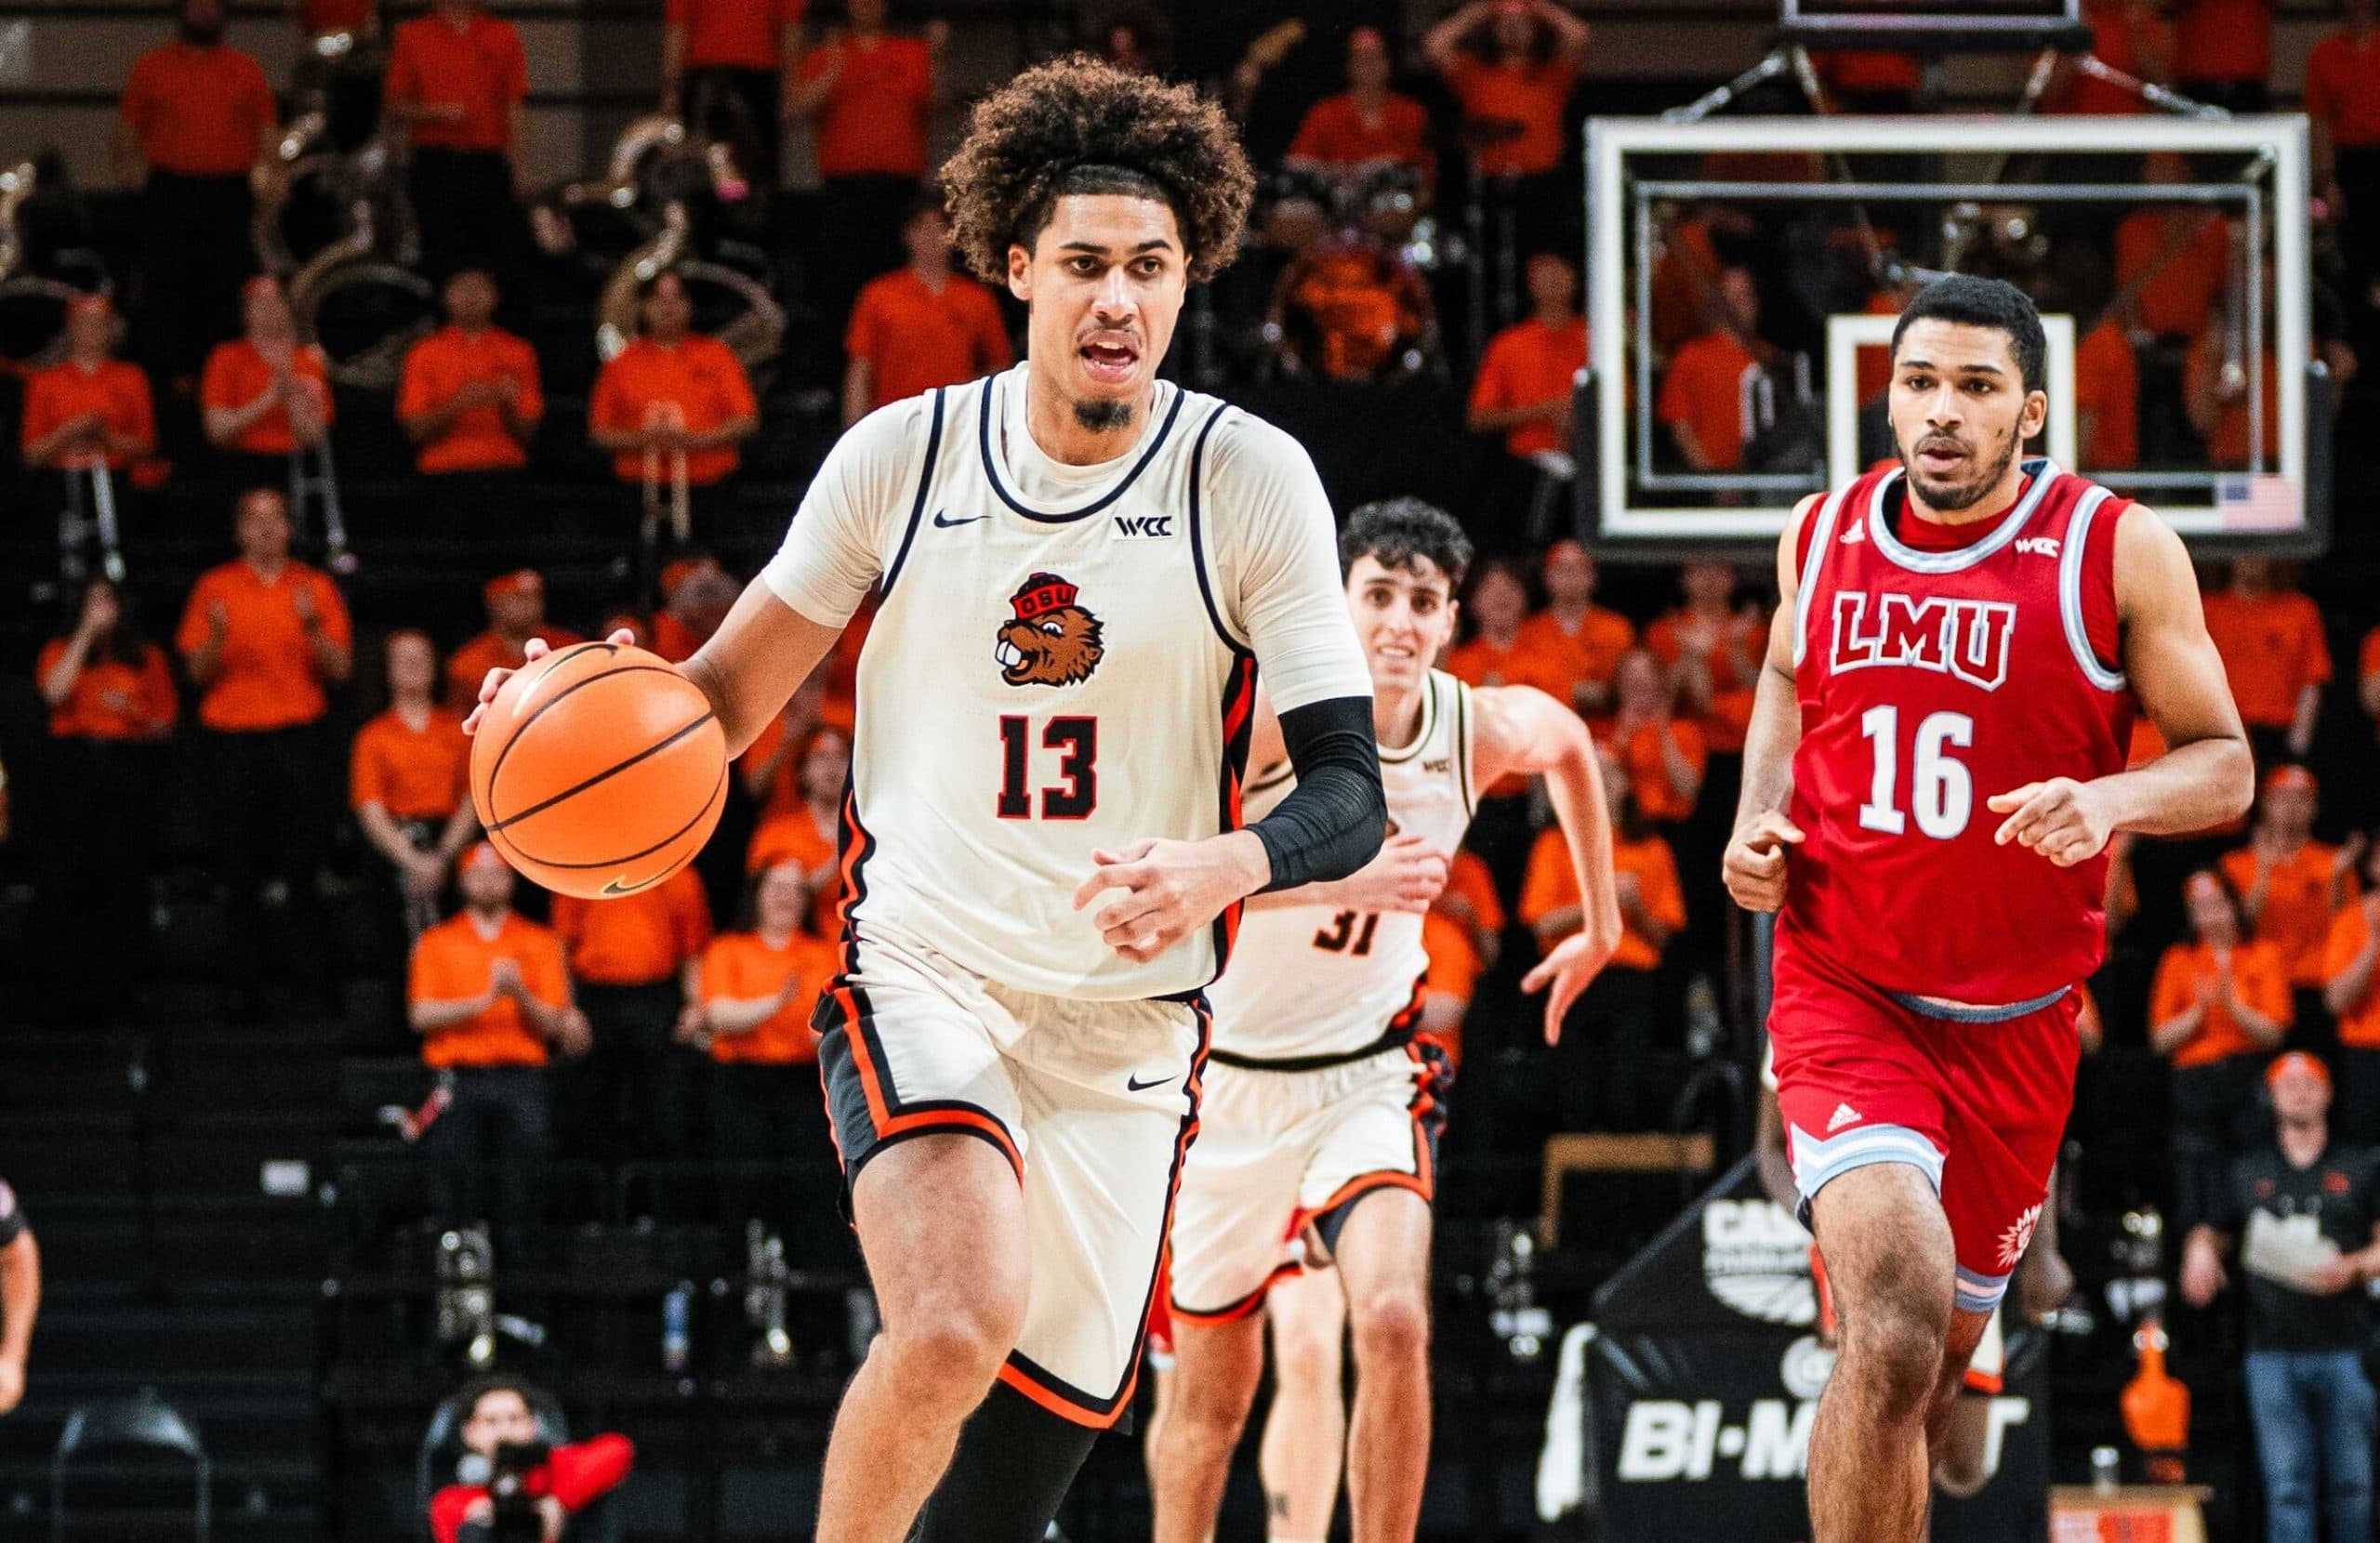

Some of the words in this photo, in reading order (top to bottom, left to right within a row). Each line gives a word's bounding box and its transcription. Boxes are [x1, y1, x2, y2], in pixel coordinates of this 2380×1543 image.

[1114, 516, 1172, 536] WCC
[2015, 537, 2060, 558] WCC
[1021, 587, 1072, 613] OSU
[1830, 590, 2016, 692] LMU
[997, 715, 1098, 820] 13
[1859, 705, 1974, 839] 16
[1312, 910, 1379, 956] 31
